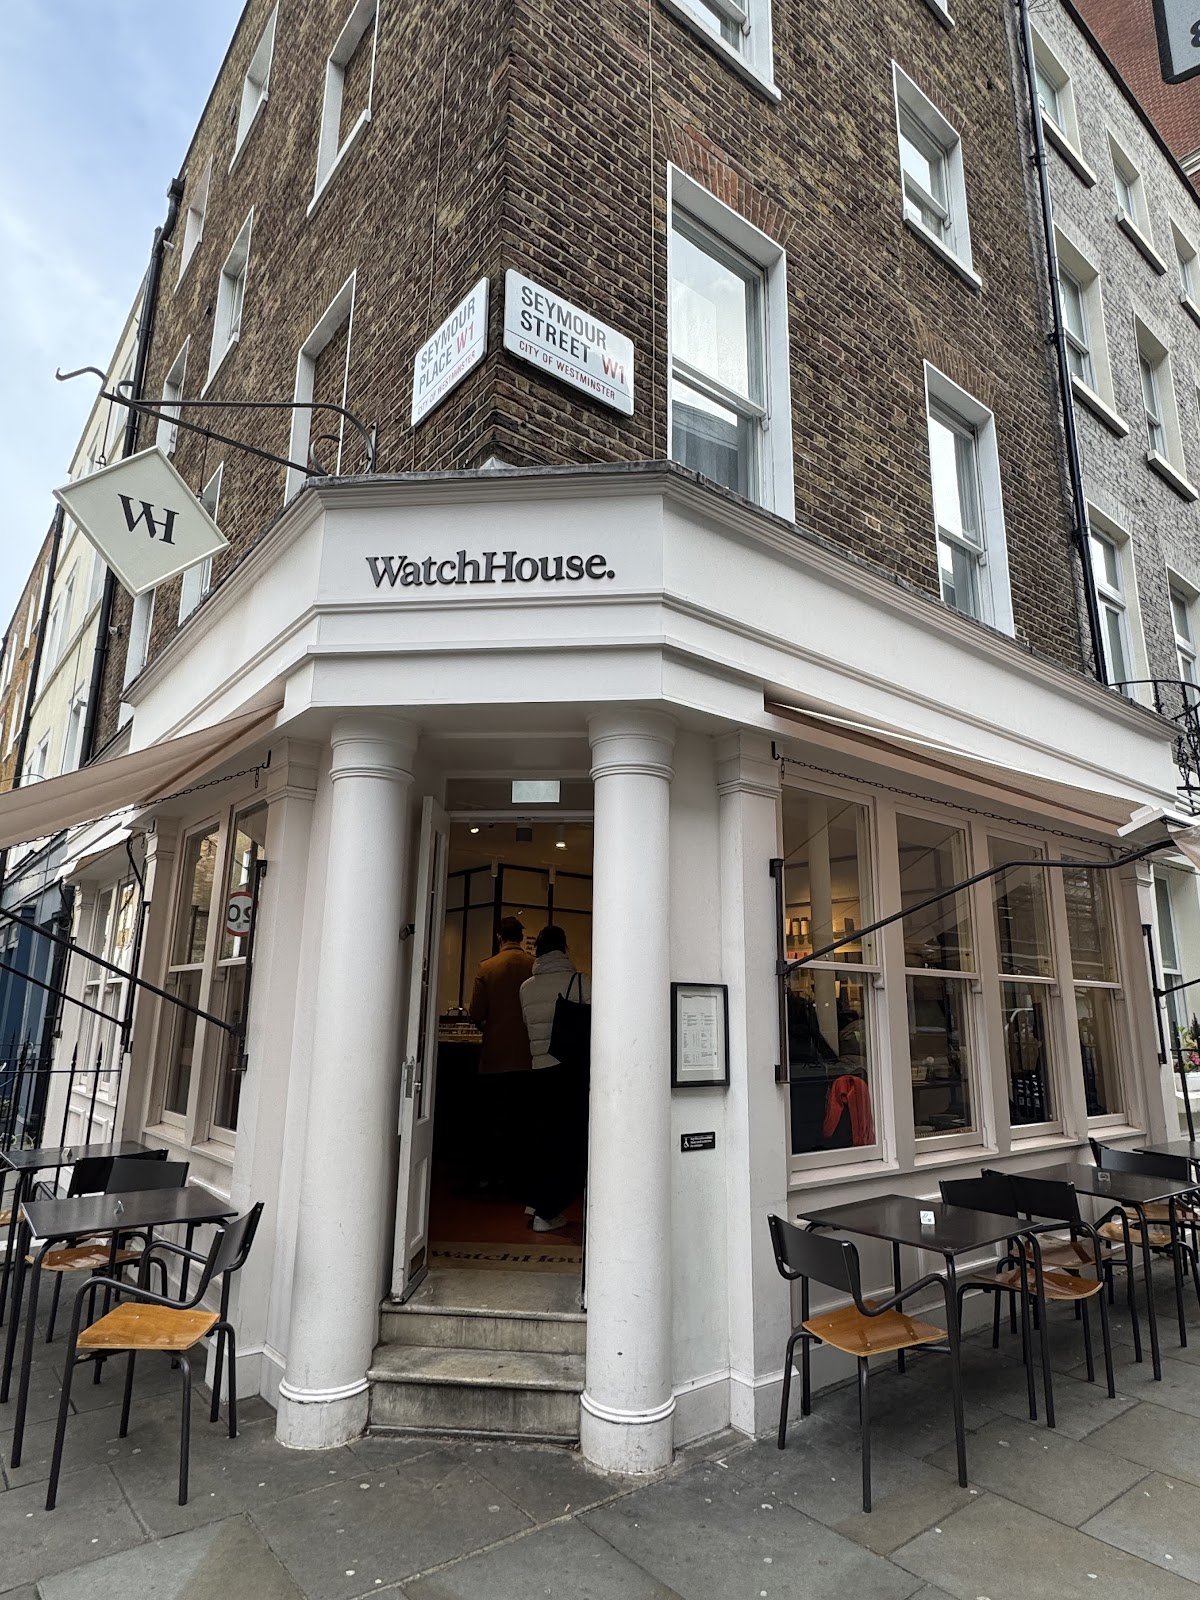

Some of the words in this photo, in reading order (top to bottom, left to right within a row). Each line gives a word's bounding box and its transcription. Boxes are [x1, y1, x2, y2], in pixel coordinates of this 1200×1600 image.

[420, 296, 475, 371] SEYMOUR
[520, 309, 591, 364] STREET
[601, 353, 625, 385] W1
[521, 285, 607, 350] SEYMOUR
[417, 398, 430, 416] CITY
[429, 391, 437, 404] OF
[437, 350, 476, 395] WESTMINSTER
[418, 344, 452, 396] PLACE
[456, 321, 475, 355] W1
[519, 340, 540, 358] CITY
[542, 352, 554, 366] OF
[555, 360, 616, 401] WESTMINSTER
[117, 493, 180, 545] WH
[365, 550, 615, 588] WatchHouse.
